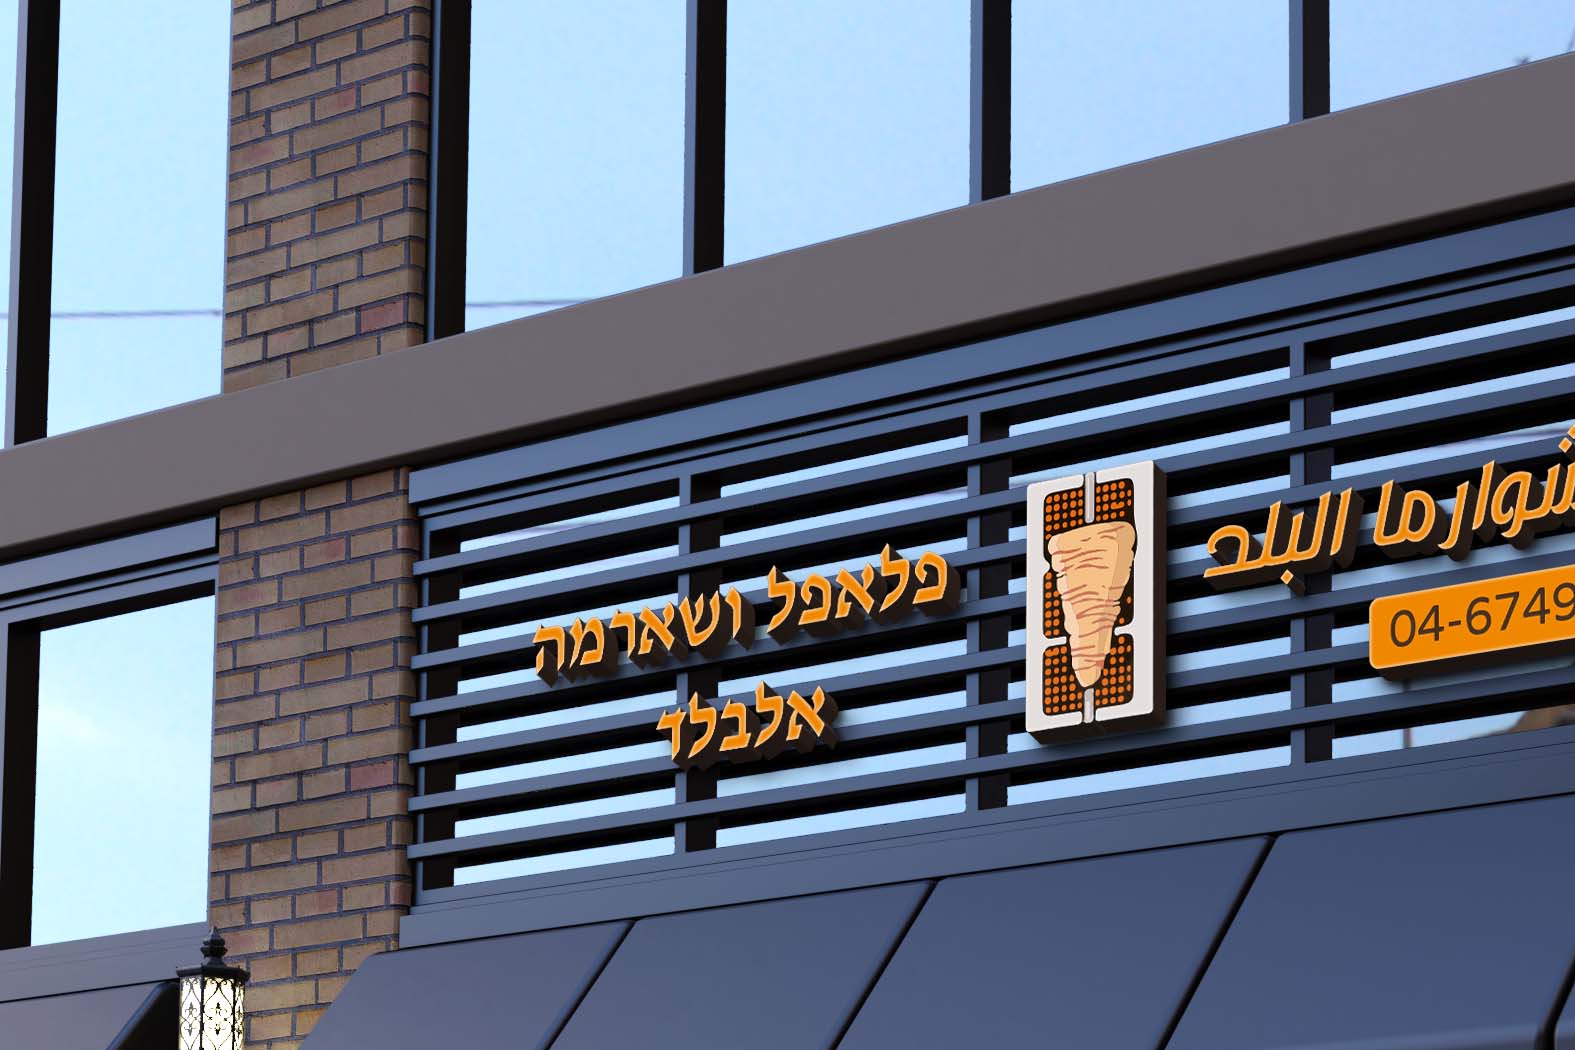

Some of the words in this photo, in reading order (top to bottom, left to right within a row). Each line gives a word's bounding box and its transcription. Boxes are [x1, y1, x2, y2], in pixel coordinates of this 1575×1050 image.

[1203, 487, 1353, 586] البلد
[533, 586, 742, 675] ושארמה
[767, 543, 949, 633] פלאפל
[655, 680, 826, 760] אלבלד
